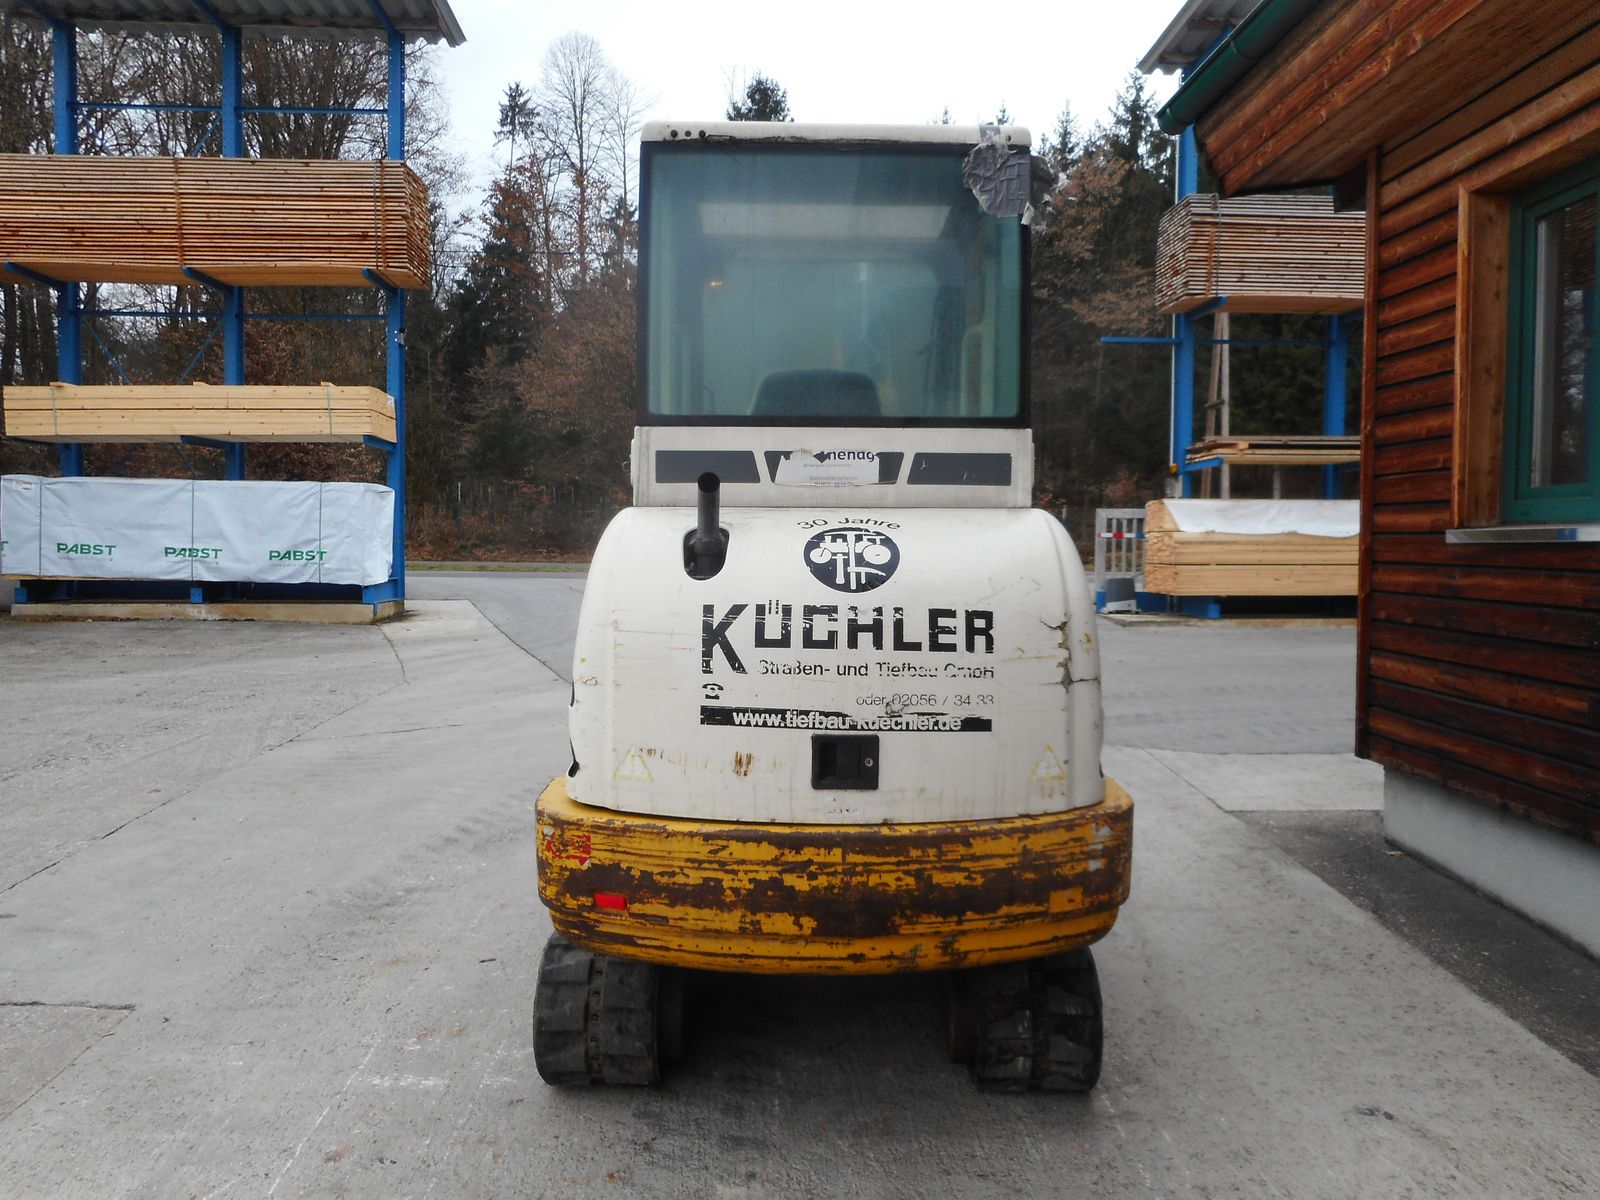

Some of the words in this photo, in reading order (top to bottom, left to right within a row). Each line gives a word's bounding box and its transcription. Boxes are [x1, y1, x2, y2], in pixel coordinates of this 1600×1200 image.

[797, 518, 828, 530] 30
[838, 517, 901, 530] Jahre
[56, 542, 117, 557] PABST
[163, 546, 223, 560] PABST
[268, 549, 328, 562] PABST
[701, 599, 994, 675] KÜCHLER
[836, 661, 869, 677] und
[855, 693, 886, 706] oder
[891, 692, 937, 707] 02056
[953, 694, 972, 706] 34
